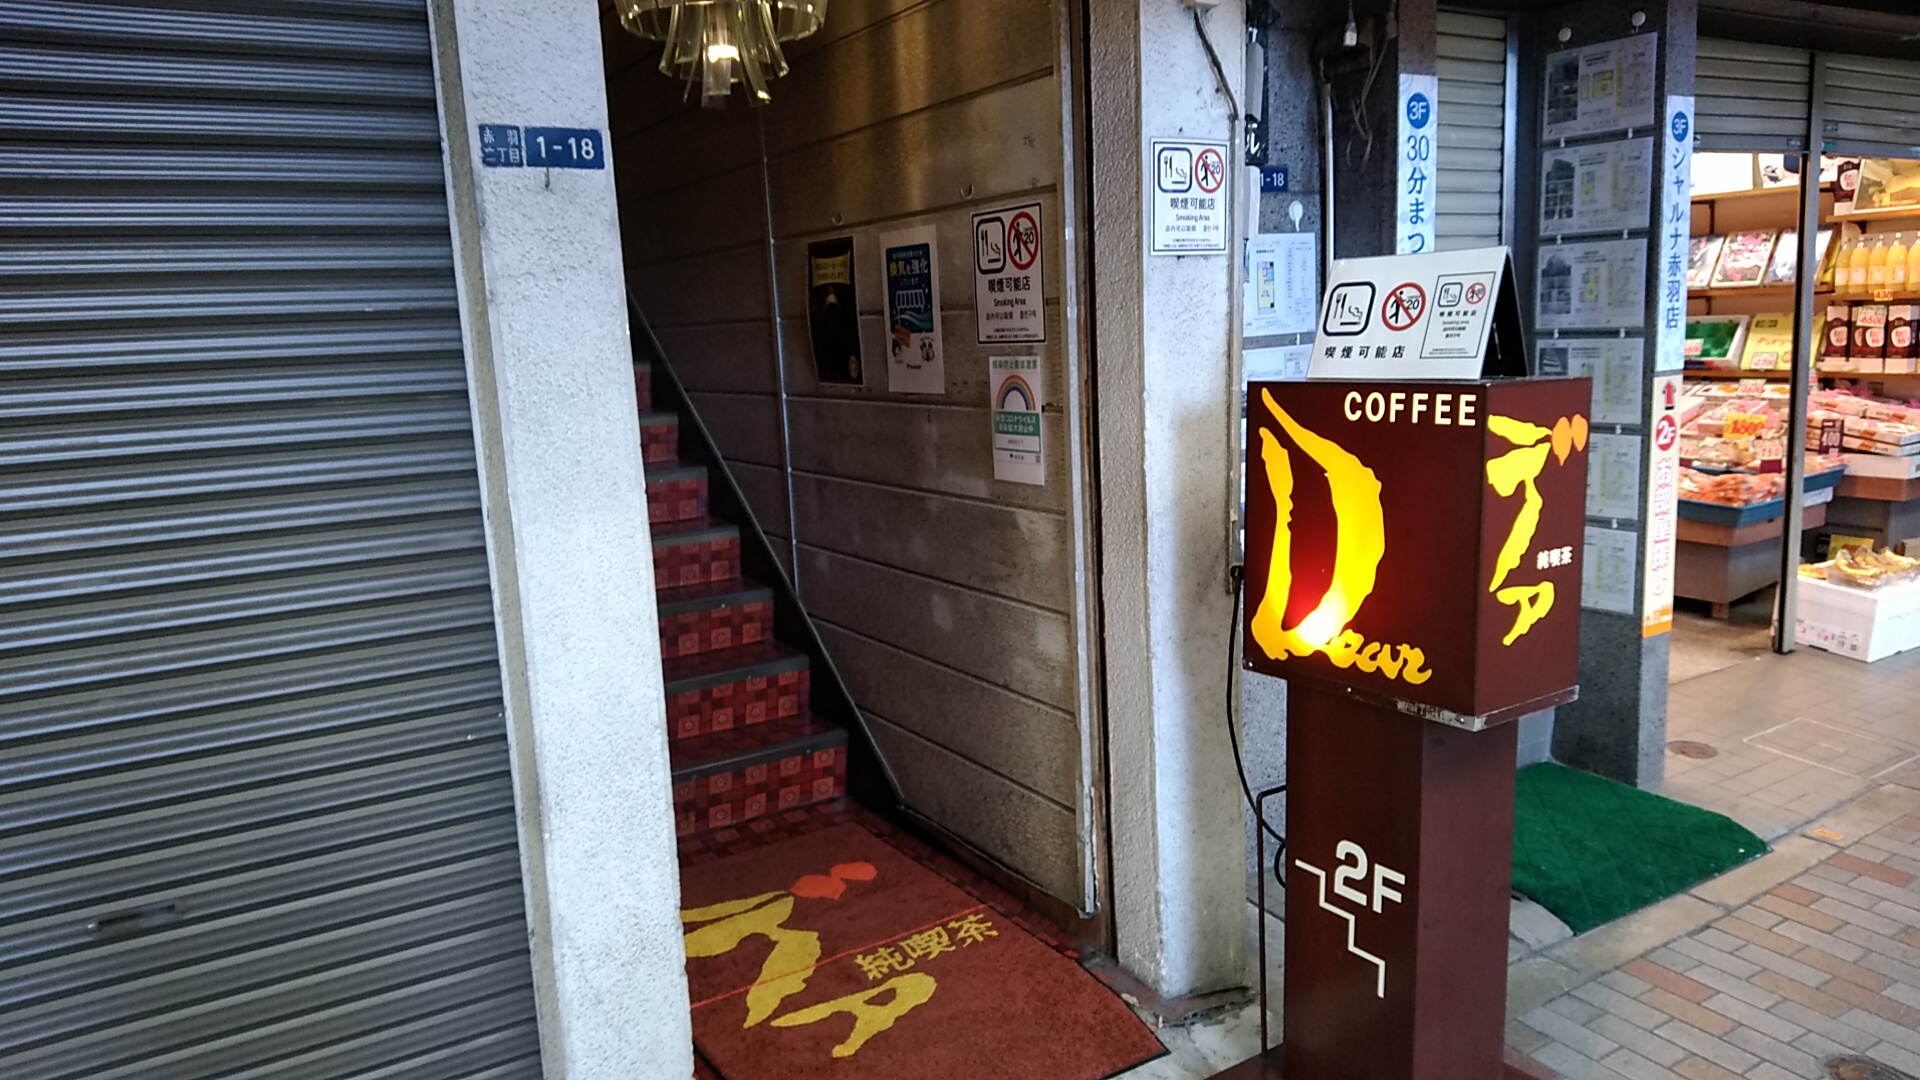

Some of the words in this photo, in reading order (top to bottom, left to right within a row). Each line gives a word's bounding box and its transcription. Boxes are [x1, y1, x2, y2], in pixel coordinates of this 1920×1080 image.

[1409, 101, 1427, 120] 3F
[1673, 118, 1687, 135] 3F
[483, 127, 519, 145] 赤羽
[536, 135, 595, 160] 1-18
[1170, 197, 1216, 210] 喫煙可能店
[1175, 214, 1198, 223] Smoking
[1665, 147, 1687, 331] シャルナ赤羽店
[987, 275, 1031, 293] 喫煙可能店
[993, 298, 1014, 308] Smoking
[1014, 297, 1026, 306] Area
[1875, 290, 1893, 300] 430
[1406, 299, 1421, 312] 20
[1324, 345, 1406, 359] 喫煙可能店
[1344, 391, 1477, 426] COFFEE
[1657, 423, 1677, 446] 2F
[1536, 546, 1574, 570] 純喫茶
[1334, 839, 1406, 914] 2F
[854, 912, 999, 980] 純喫茶
